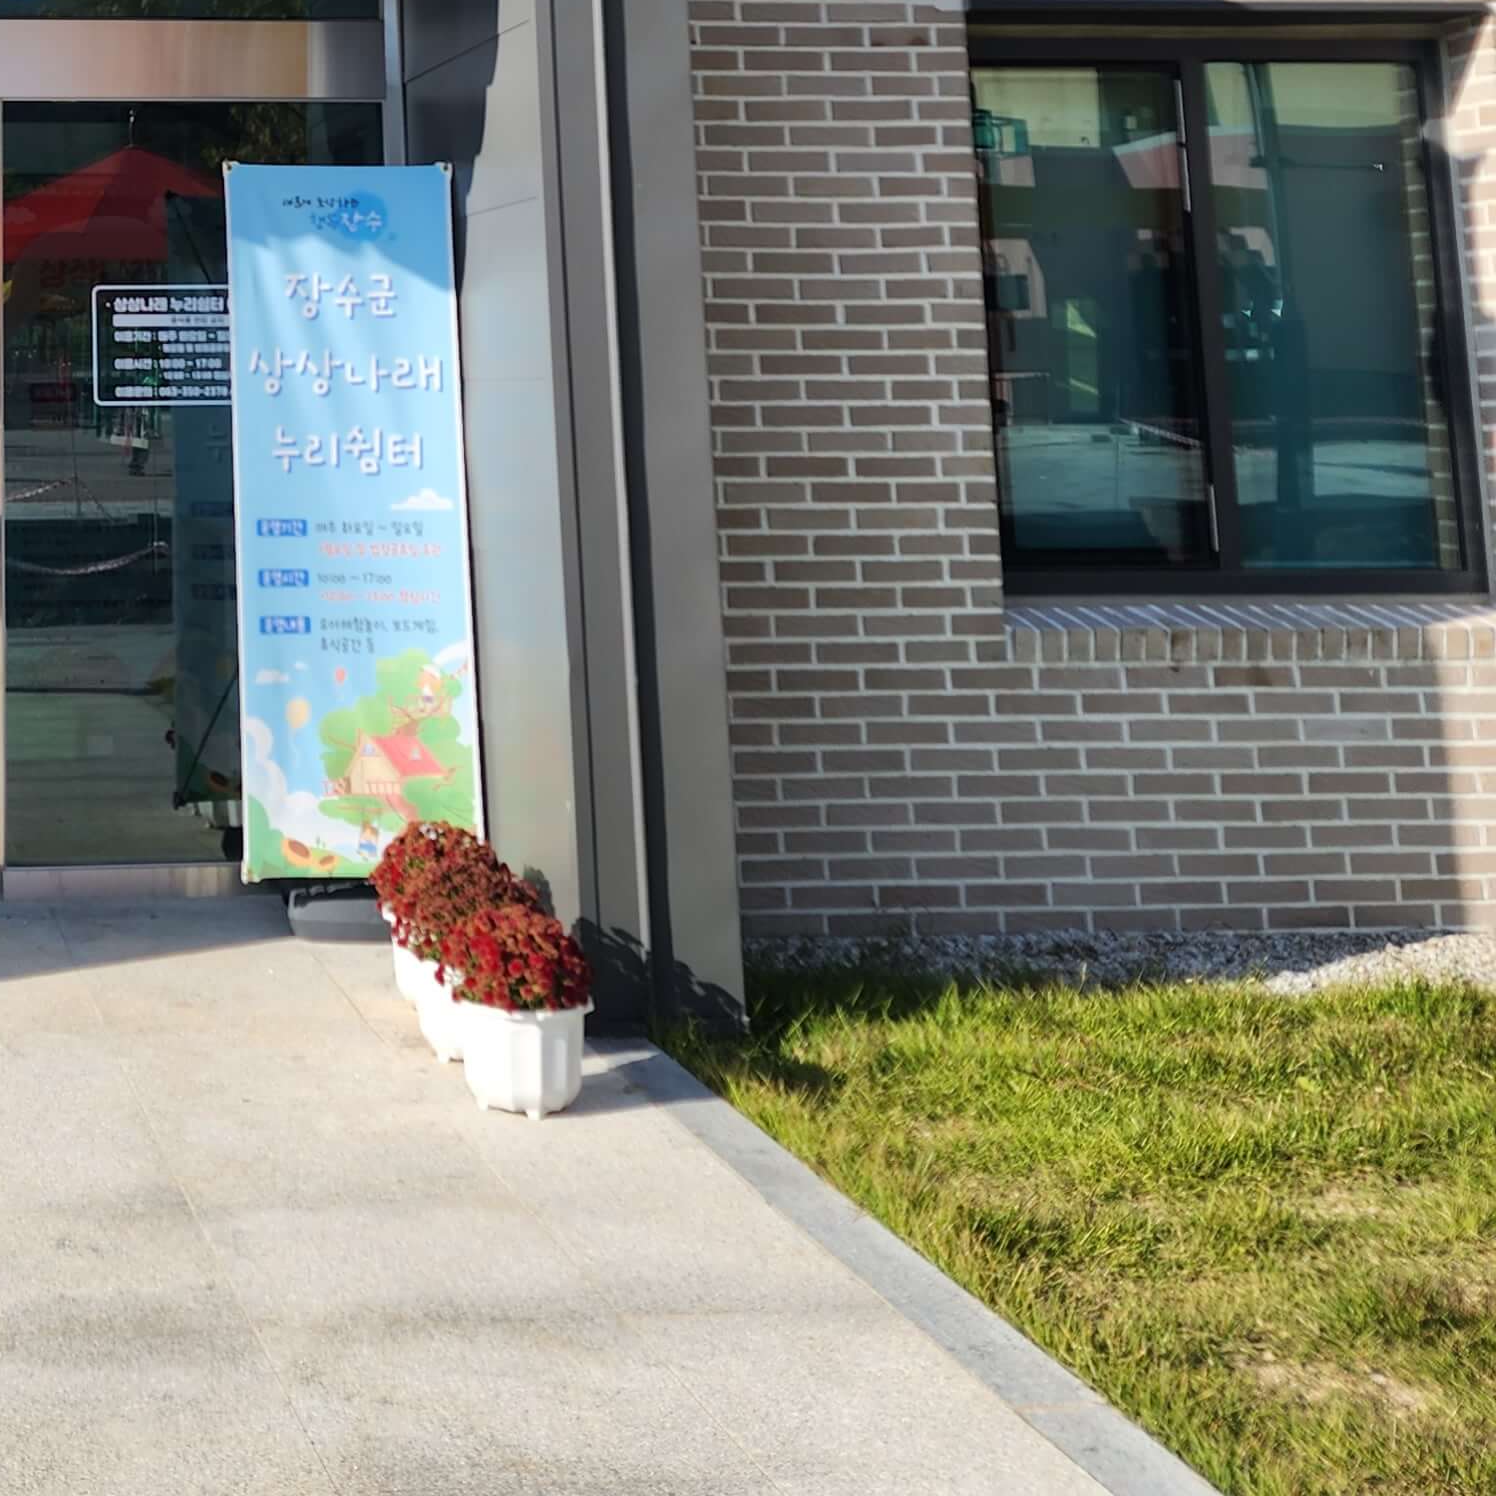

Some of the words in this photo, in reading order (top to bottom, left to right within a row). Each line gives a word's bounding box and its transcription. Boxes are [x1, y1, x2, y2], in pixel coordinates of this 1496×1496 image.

[284, 271, 398, 320] 장수군
[249, 345, 443, 397] 상상나래
[271, 424, 424, 475] 누리쉼터
